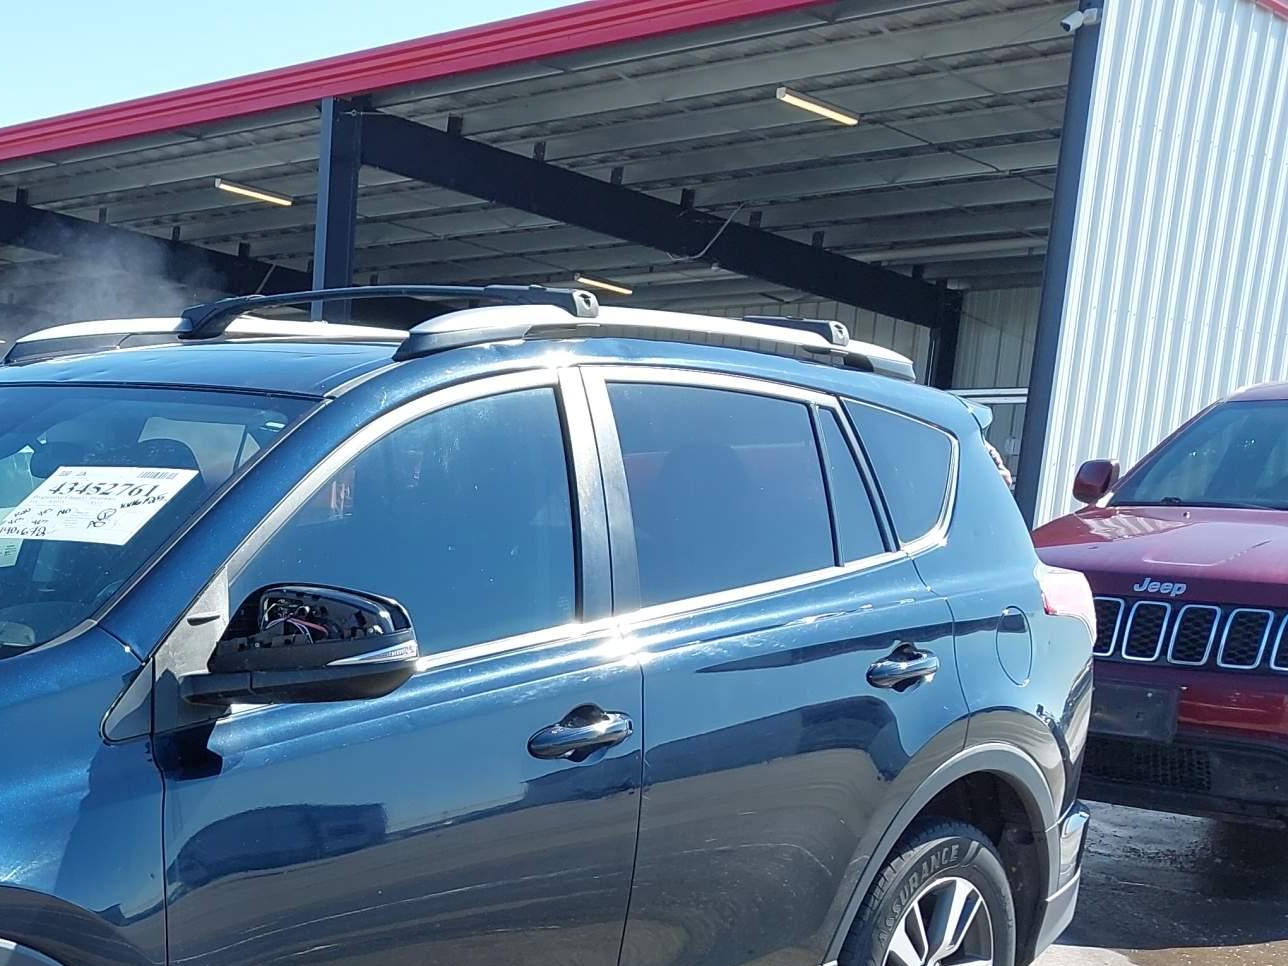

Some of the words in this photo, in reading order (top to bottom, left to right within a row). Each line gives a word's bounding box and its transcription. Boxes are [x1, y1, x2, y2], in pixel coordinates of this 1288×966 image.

[48, 481, 160, 497] 43452761
[1133, 577, 1187, 597] Jeep
[878, 844, 960, 948] ASSURANCE
